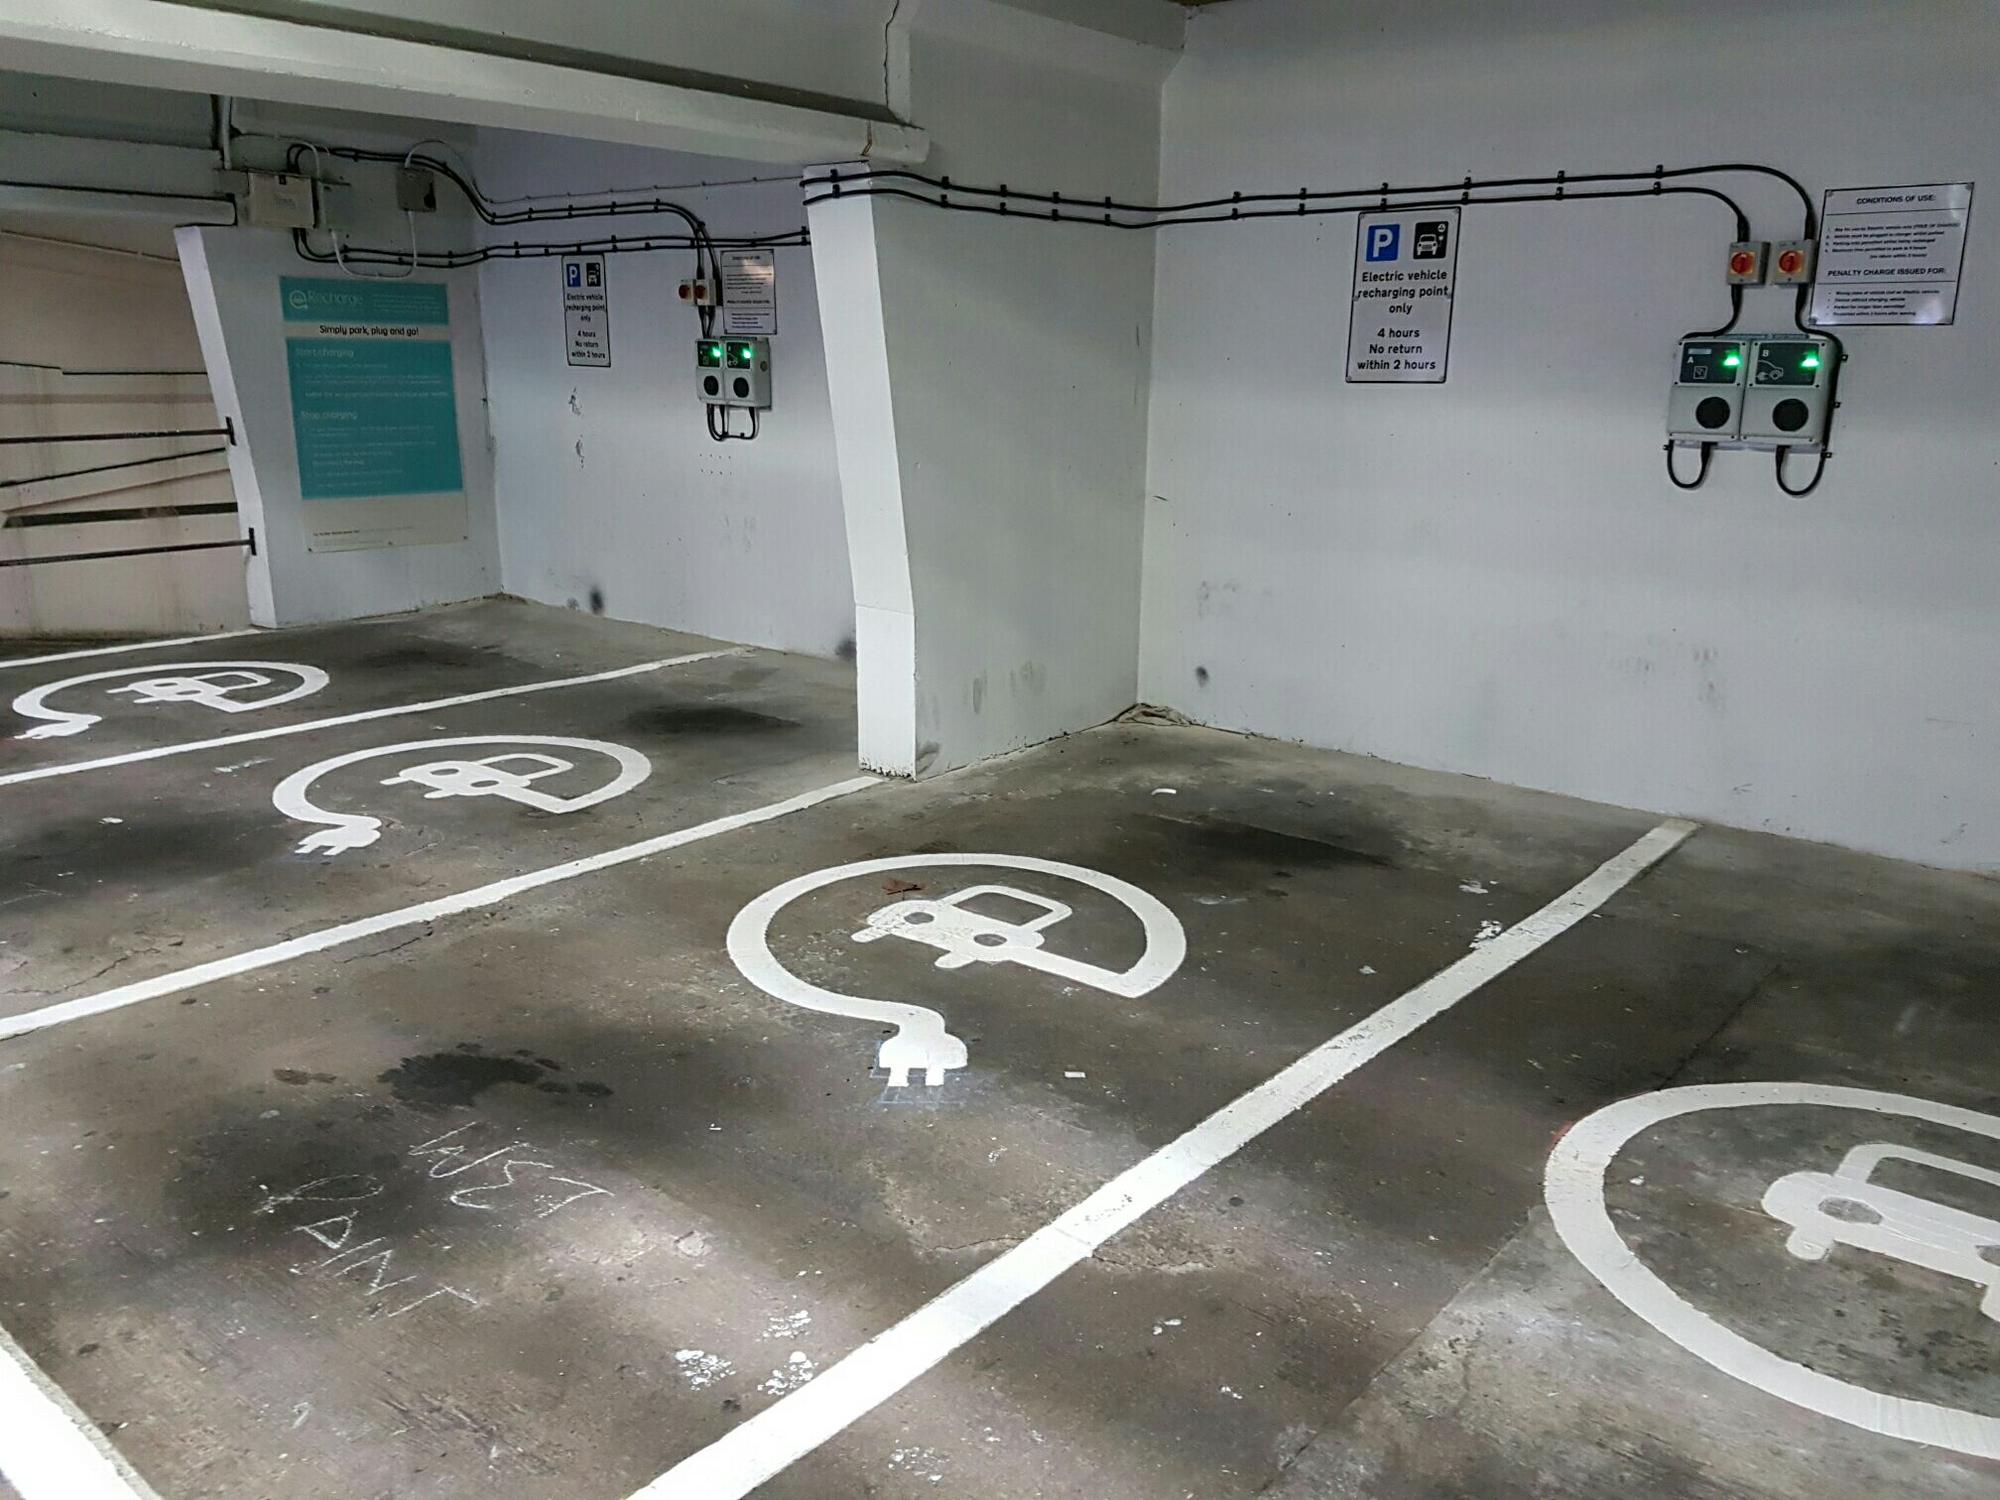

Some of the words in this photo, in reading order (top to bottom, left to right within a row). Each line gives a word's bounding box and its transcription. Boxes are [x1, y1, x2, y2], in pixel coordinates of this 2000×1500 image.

[1856, 195, 1904, 205] CONDITIONS
[1905, 195, 1916, 203] OF
[1373, 228, 1393, 258] P
[1361, 271, 1405, 282] Electric
[1407, 269, 1448, 281] vehicle
[1827, 269, 1862, 277] PENALTY
[1863, 268, 1897, 276] CHARGE
[1897, 267, 1926, 275] ISSUED
[1357, 288, 1416, 300] recharging
[1419, 286, 1449, 299] point
[1388, 303, 1413, 315] only
[319, 325, 348, 336] Simply
[349, 325, 370, 336] park,
[371, 326, 388, 337] plug
[389, 326, 405, 336] and
[406, 327, 420, 338] go!
[1377, 328, 1386, 338] 4
[1388, 328, 1421, 338] hours
[1369, 344, 1385, 354] No
[1387, 344, 1423, 354] return
[1357, 360, 1390, 370] within
[1393, 359, 1402, 370] 2
[1404, 359, 1437, 370] hours
